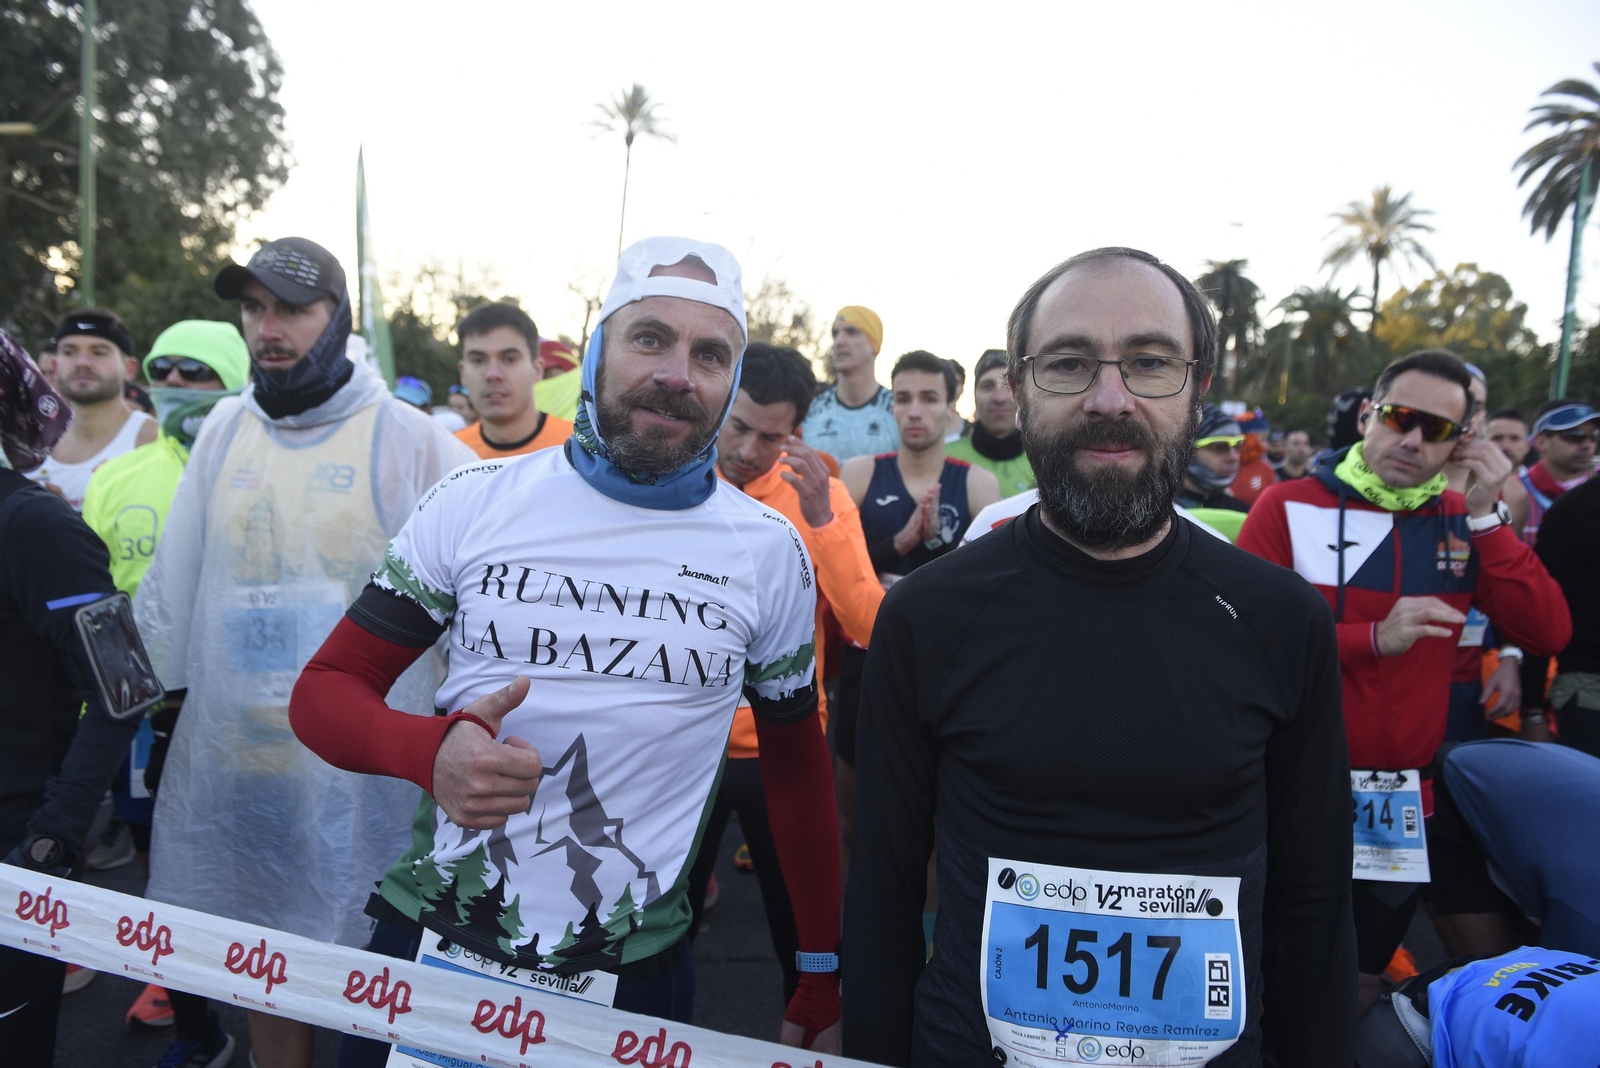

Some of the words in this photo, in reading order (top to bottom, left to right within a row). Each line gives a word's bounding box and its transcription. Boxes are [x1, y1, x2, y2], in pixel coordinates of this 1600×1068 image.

[762, 512, 788, 527] textil
[788, 527, 812, 589] Carreras
[678, 564, 720, 585] Juanma
[476, 563, 729, 631] RUNNING
[1215, 594, 1239, 620] KIPRUN
[459, 610, 510, 661] LA
[523, 626, 732, 688] BAZANA
[1352, 798, 1395, 831] 14
[16, 886, 69, 938] edp
[1043, 878, 1087, 906] edp
[1118, 884, 1196, 902] maratón
[1139, 898, 1196, 915] sevilla
[117, 913, 173, 965] edp
[225, 940, 286, 993] edp
[529, 972, 579, 995] sevilla
[1025, 924, 1182, 1001] 1517
[344, 969, 411, 1023] edp
[1072, 999, 1140, 1013] AntonioMarino
[472, 997, 545, 1054] edp
[1004, 1007, 1058, 1026] Antonio
[1062, 1016, 1112, 1032] Marino
[1116, 1021, 1159, 1036] Reyes
[1163, 1023, 1220, 1037] Ramírez
[1105, 1039, 1145, 1064] edp
